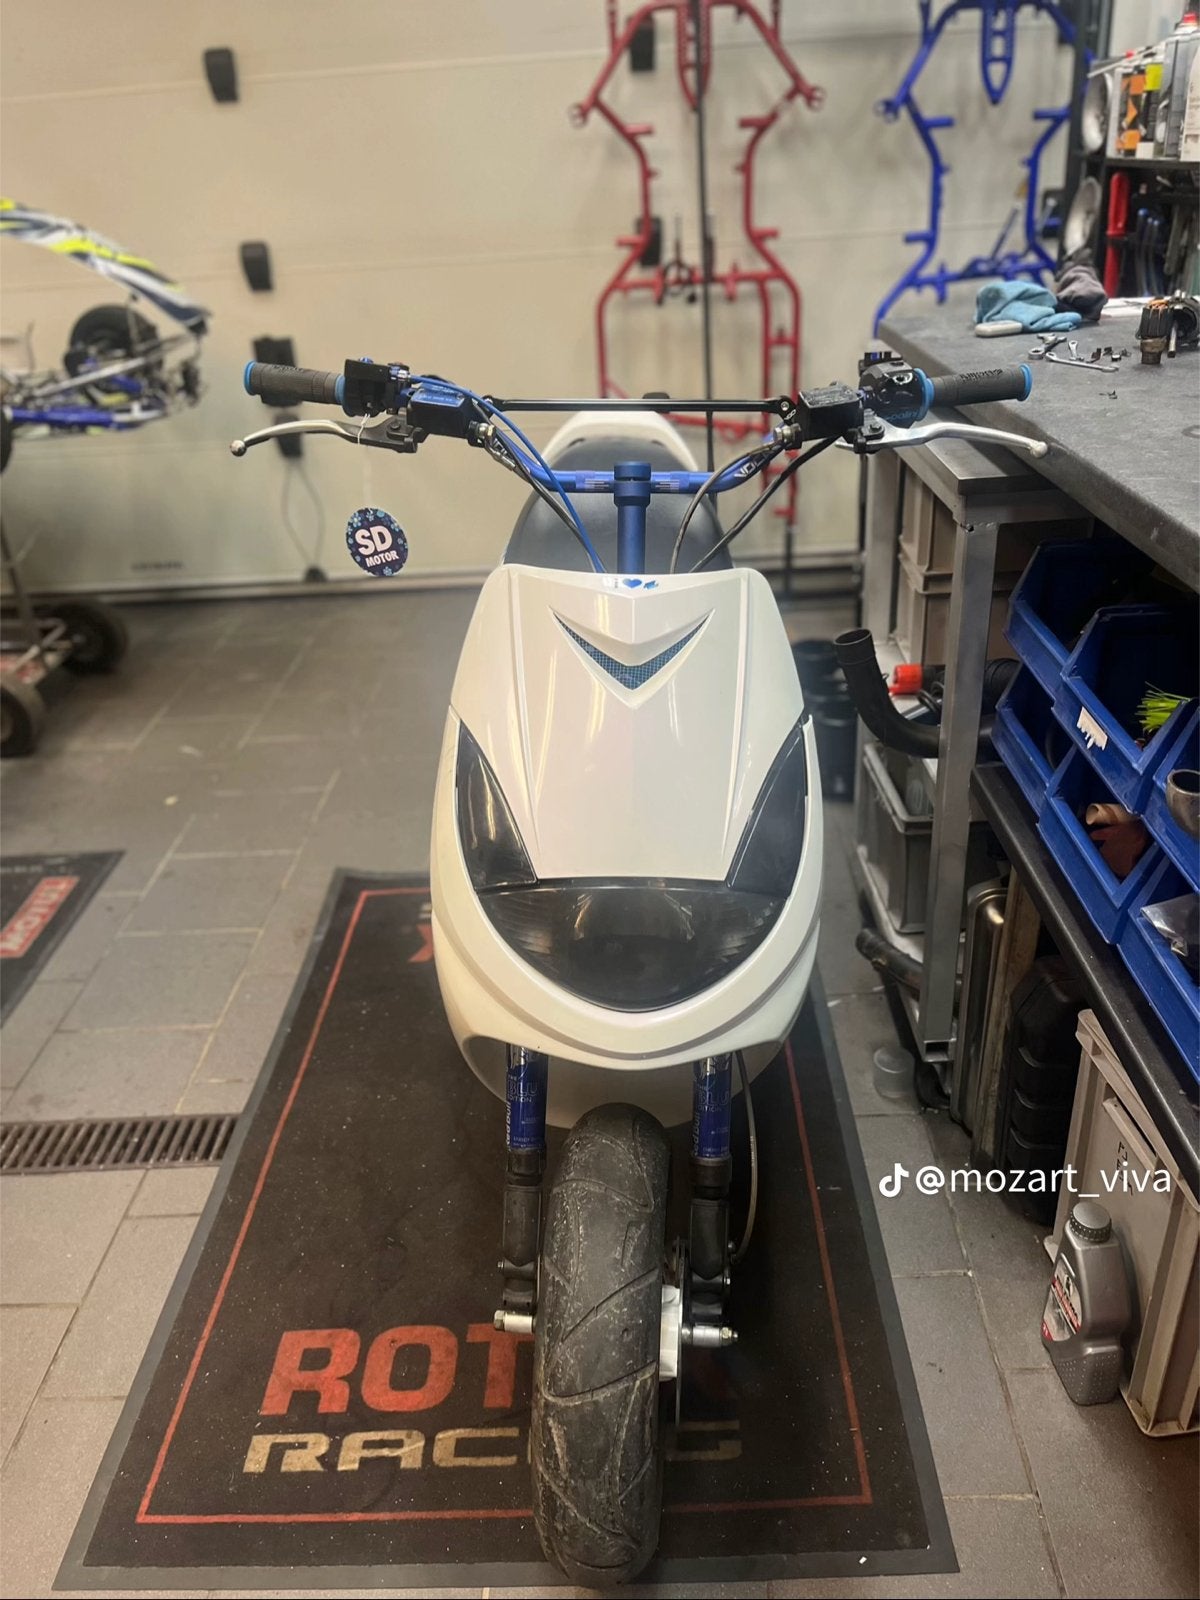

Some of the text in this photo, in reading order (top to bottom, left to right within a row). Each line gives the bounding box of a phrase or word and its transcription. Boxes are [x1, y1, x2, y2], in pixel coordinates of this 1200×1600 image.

[355, 525, 393, 556] SD
[365, 550, 399, 567] MOTOR
[507, 1081, 538, 1097] BLU
[698, 1090, 729, 1105] BLU
[260, 1324, 534, 1416] ROT
